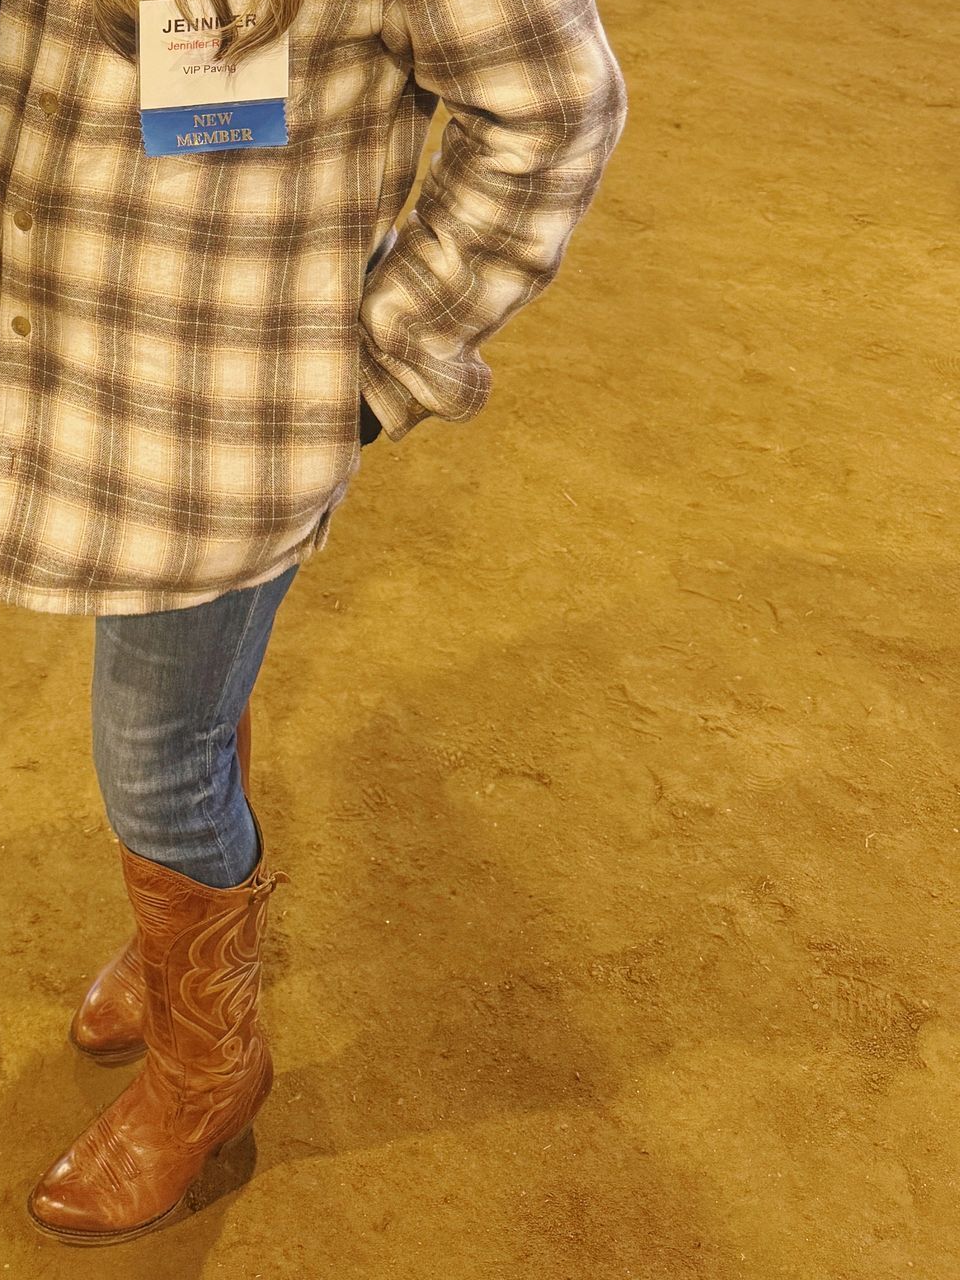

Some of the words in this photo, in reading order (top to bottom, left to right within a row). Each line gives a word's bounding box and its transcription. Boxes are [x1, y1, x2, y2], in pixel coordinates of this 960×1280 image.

[162, 14, 257, 35] JENNIER
[167, 39, 208, 51] Jennifer
[182, 65, 201, 75] VIP
[193, 112, 233, 128] NEW
[176, 128, 254, 147] MEMBER
